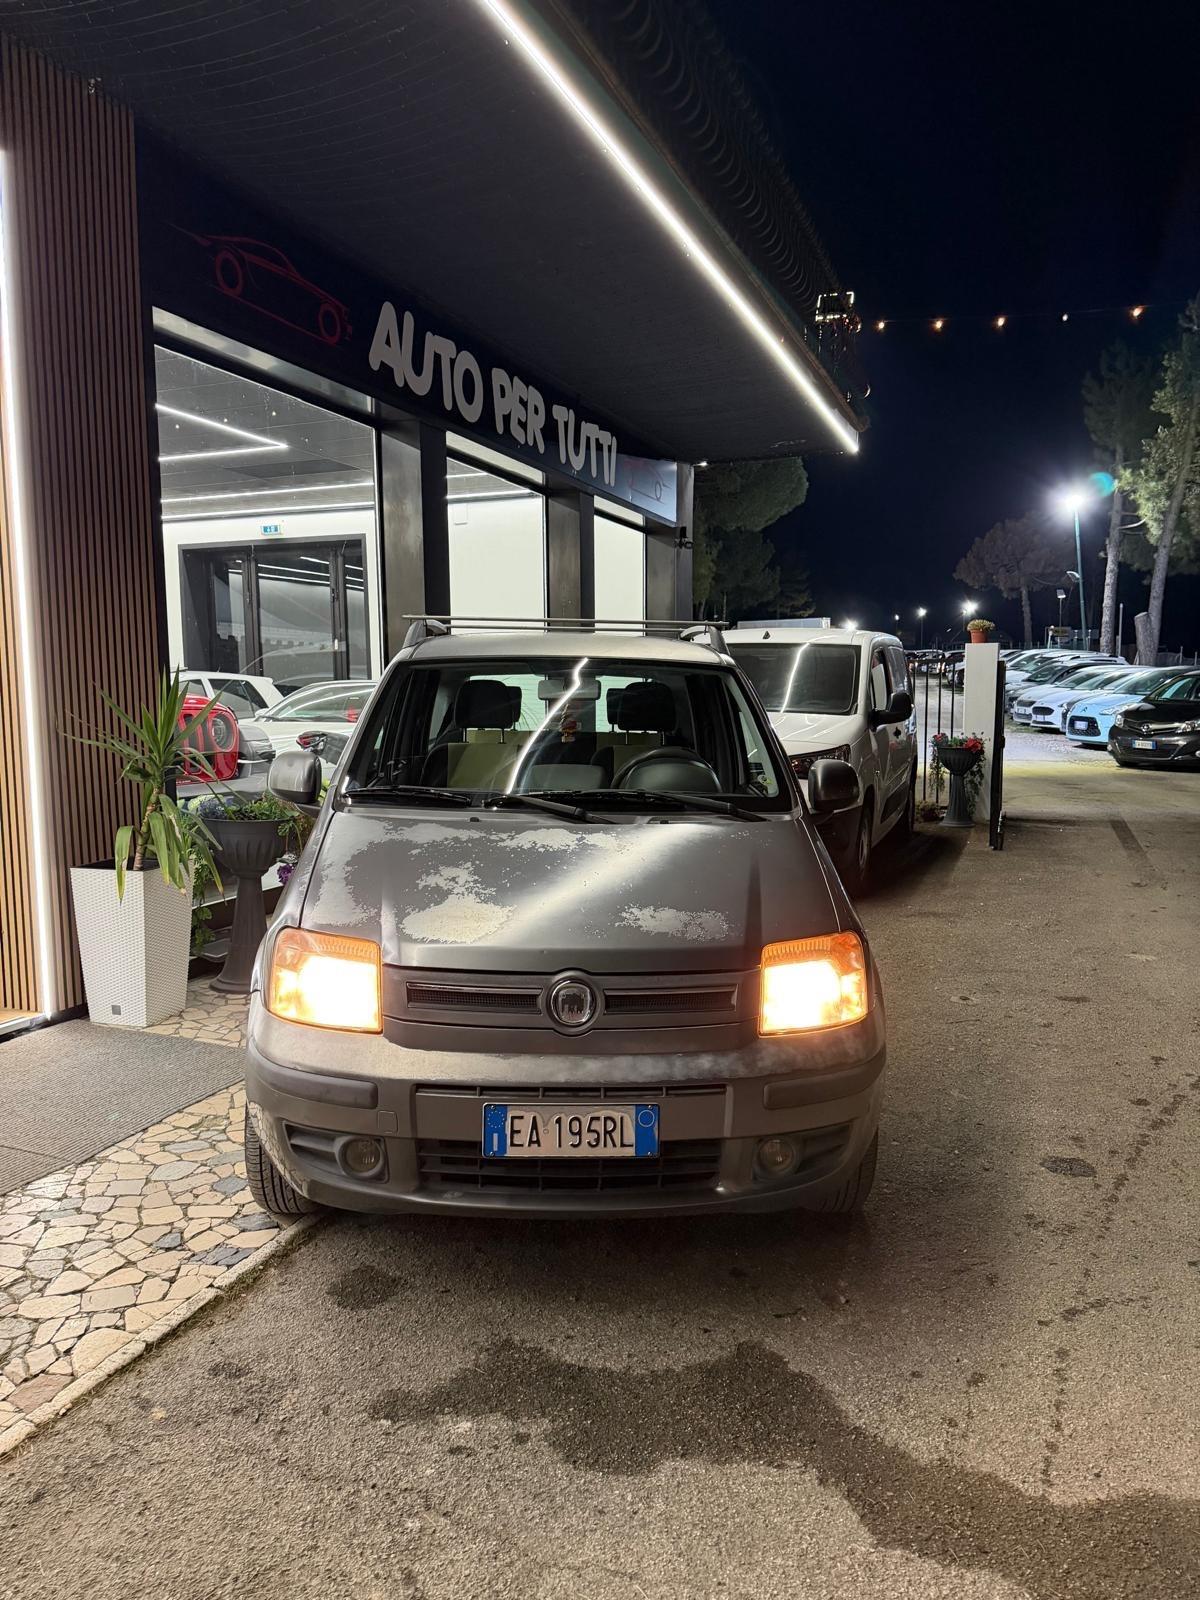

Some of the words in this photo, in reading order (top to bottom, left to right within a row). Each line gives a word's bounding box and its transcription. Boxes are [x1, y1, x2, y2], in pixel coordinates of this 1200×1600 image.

[369, 301, 484, 423] AUTO
[491, 367, 545, 454] PER
[552, 404, 617, 487] TUTTI
